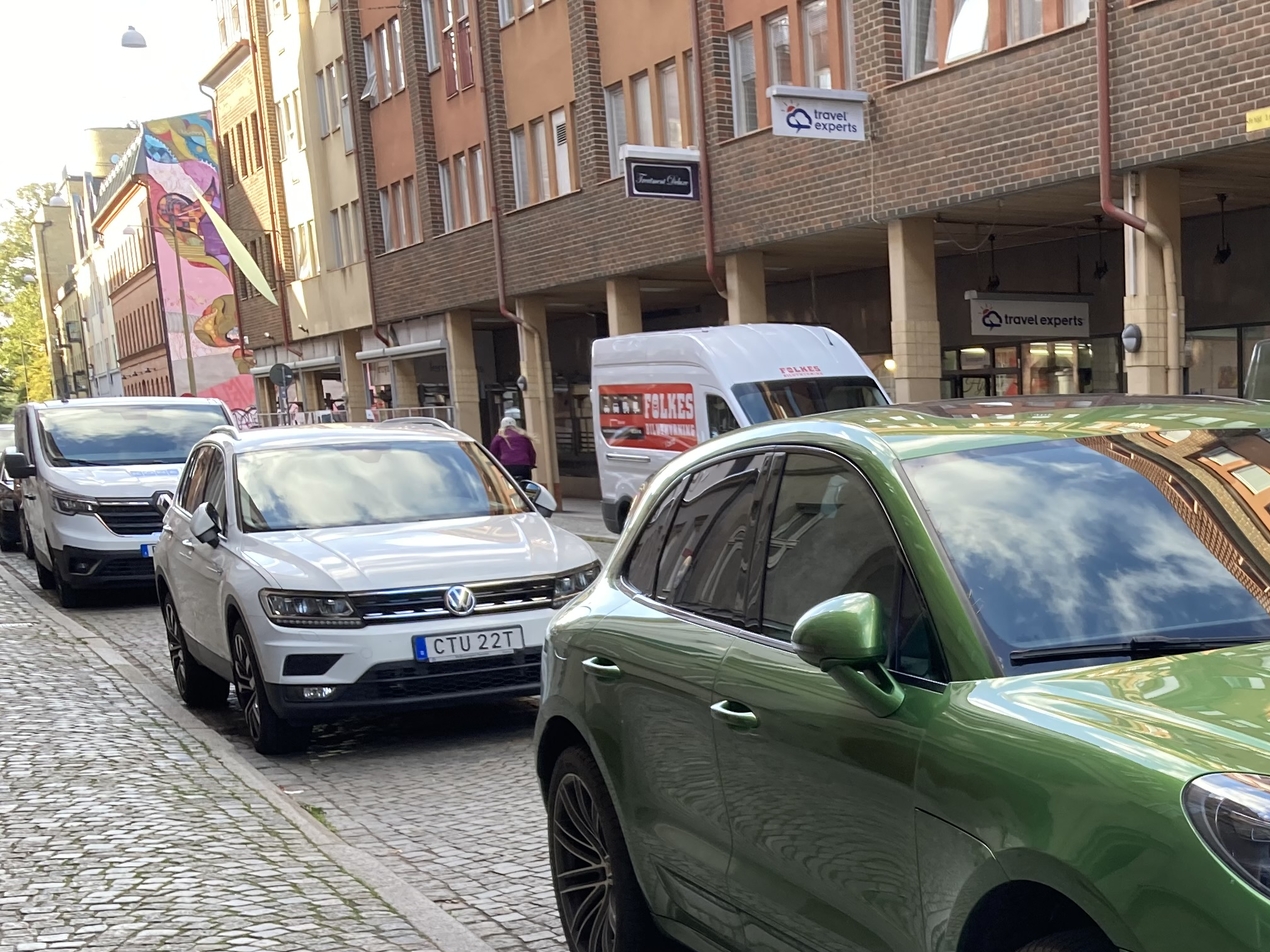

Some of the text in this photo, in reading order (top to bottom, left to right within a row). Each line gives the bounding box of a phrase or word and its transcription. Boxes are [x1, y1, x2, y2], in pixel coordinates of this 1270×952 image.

[814, 109, 847, 121] travel
[814, 121, 857, 133] experts
[1005, 314, 1083, 327] travel experts
[779, 365, 821, 374] FOLKES
[644, 393, 695, 419] FOLKES
[433, 631, 513, 655] CTU 22T
